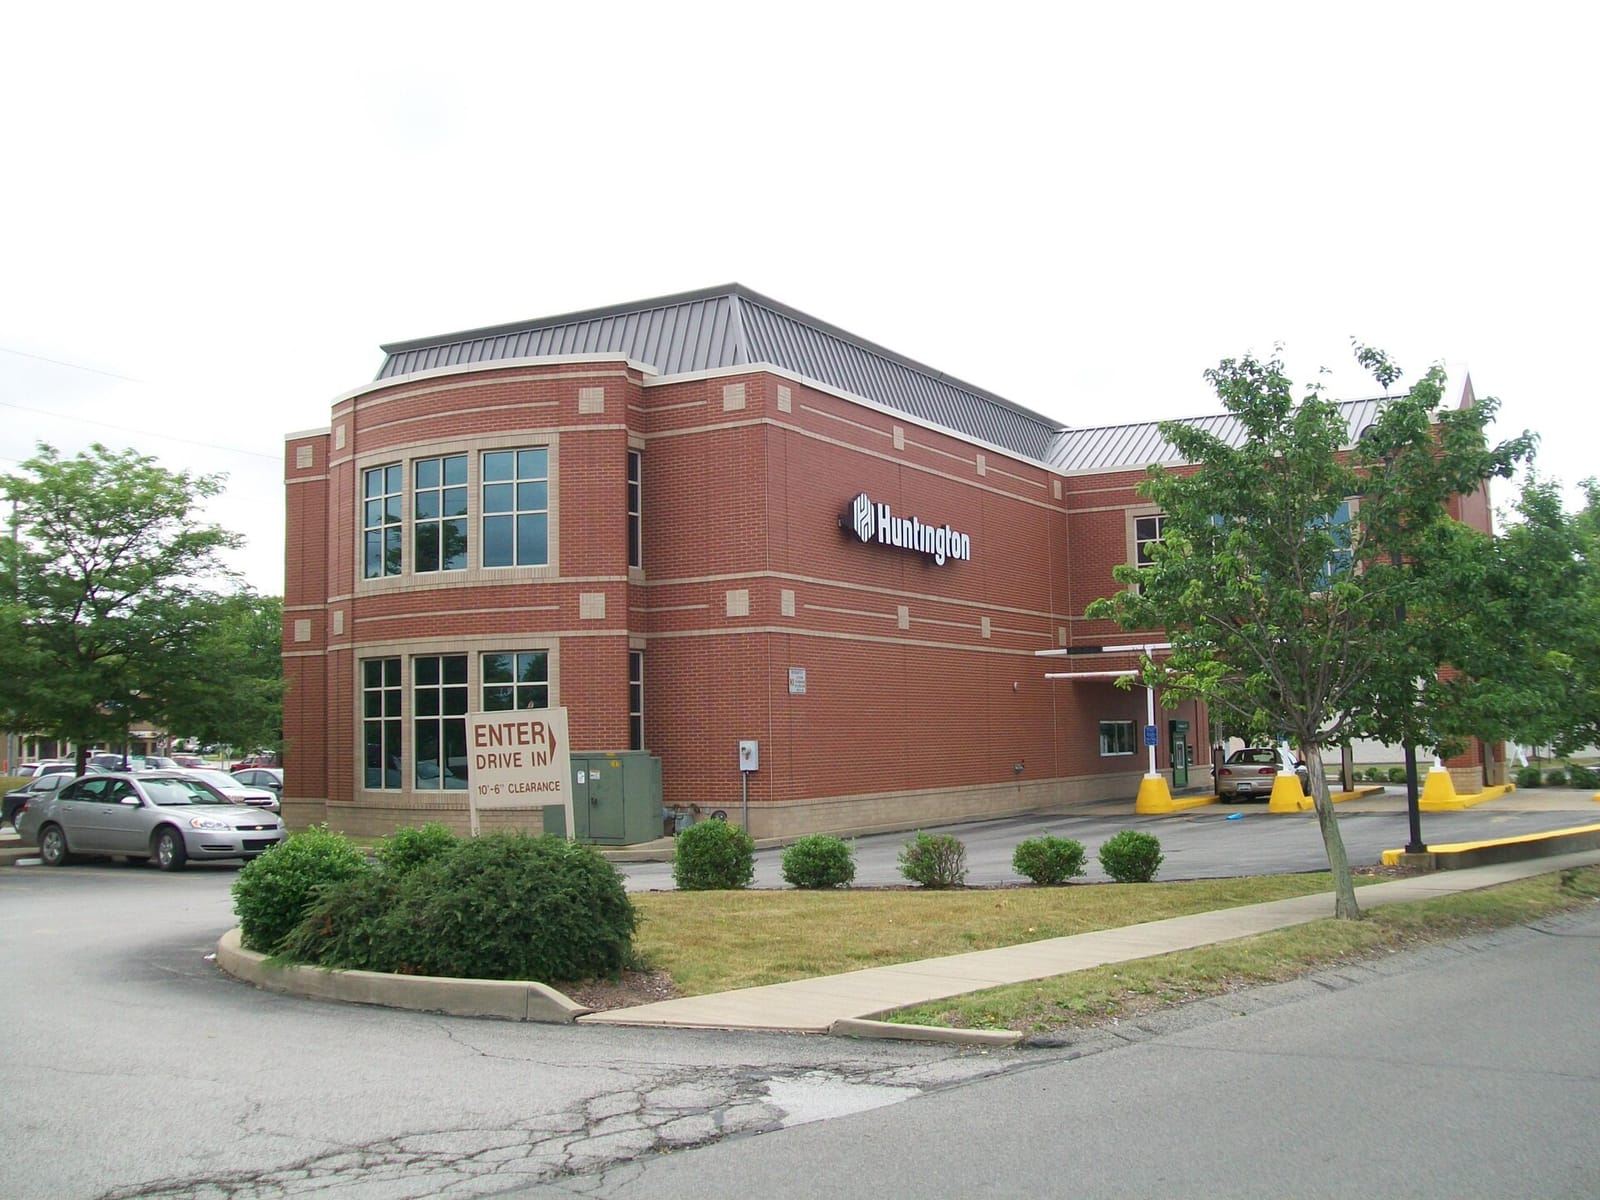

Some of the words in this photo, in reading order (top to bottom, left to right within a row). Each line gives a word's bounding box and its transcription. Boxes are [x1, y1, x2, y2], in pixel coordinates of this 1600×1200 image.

[877, 502, 971, 566] Huntington
[474, 721, 546, 748] ENTER
[476, 752, 523, 770] DRIVE
[531, 751, 548, 767] IN
[508, 780, 561, 794] CLEARANCE
